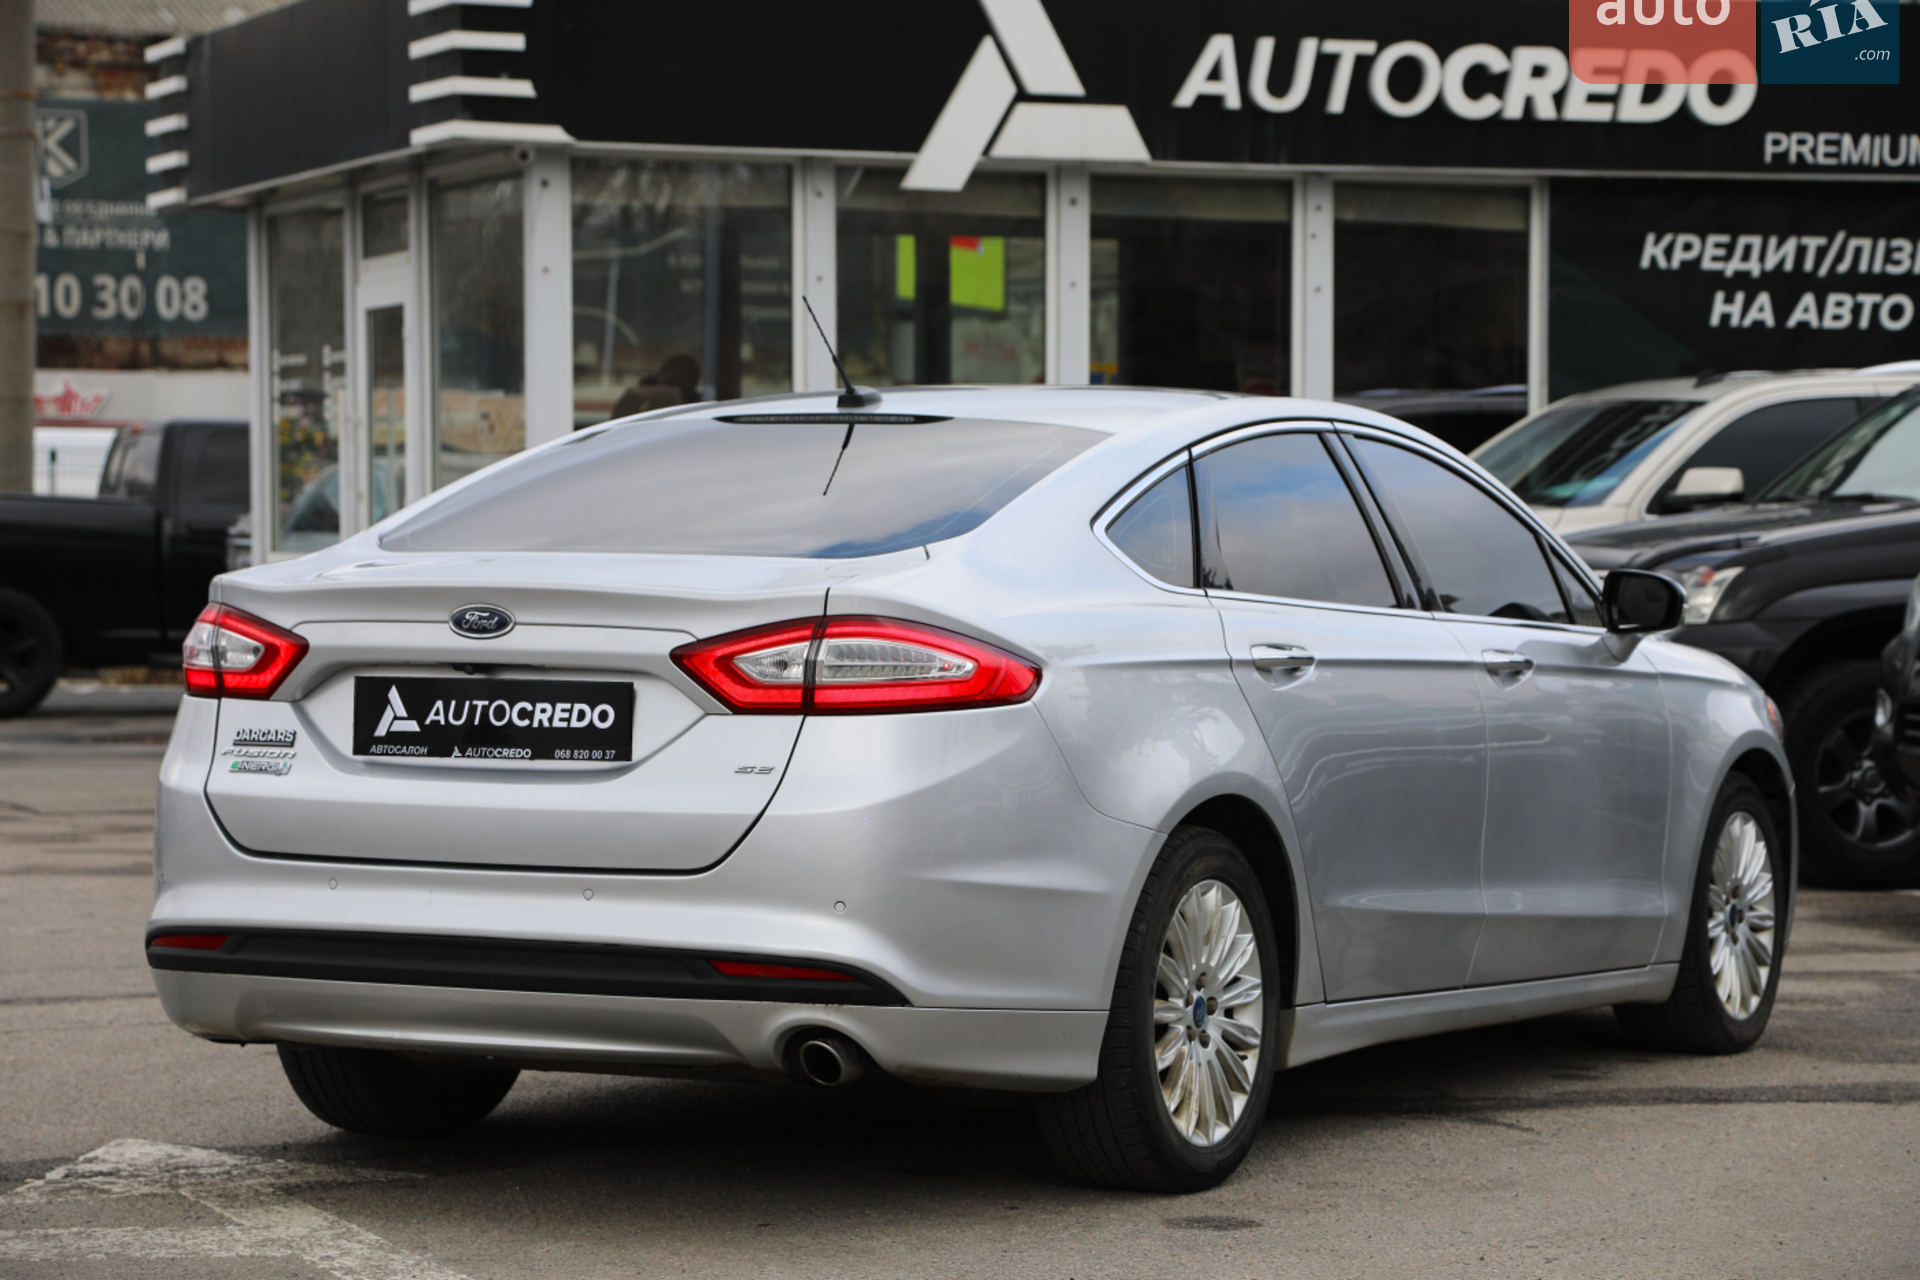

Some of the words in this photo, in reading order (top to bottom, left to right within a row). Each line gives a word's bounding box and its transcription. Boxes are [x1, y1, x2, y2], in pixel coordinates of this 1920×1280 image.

[1172, 33, 1758, 126] AUTOCREDO
[1639, 230, 1920, 278] КРЕДИТ/ЛІЗ
[91, 273, 144, 320] 30
[155, 274, 209, 322] 08
[1708, 290, 1776, 328] НА
[1785, 291, 1915, 331] АВТО
[462, 611, 499, 630] Ford
[424, 699, 615, 729] AUTOCREDO
[234, 728, 296, 742] DARCARS
[221, 747, 296, 758] FUSION
[369, 744, 428, 756] АВТОСАЛОН
[465, 747, 532, 759] AUTOCREDO
[554, 748, 571, 759] 068
[573, 749, 590, 760] 820
[591, 750, 603, 760] 00
[604, 750, 616, 760] 37
